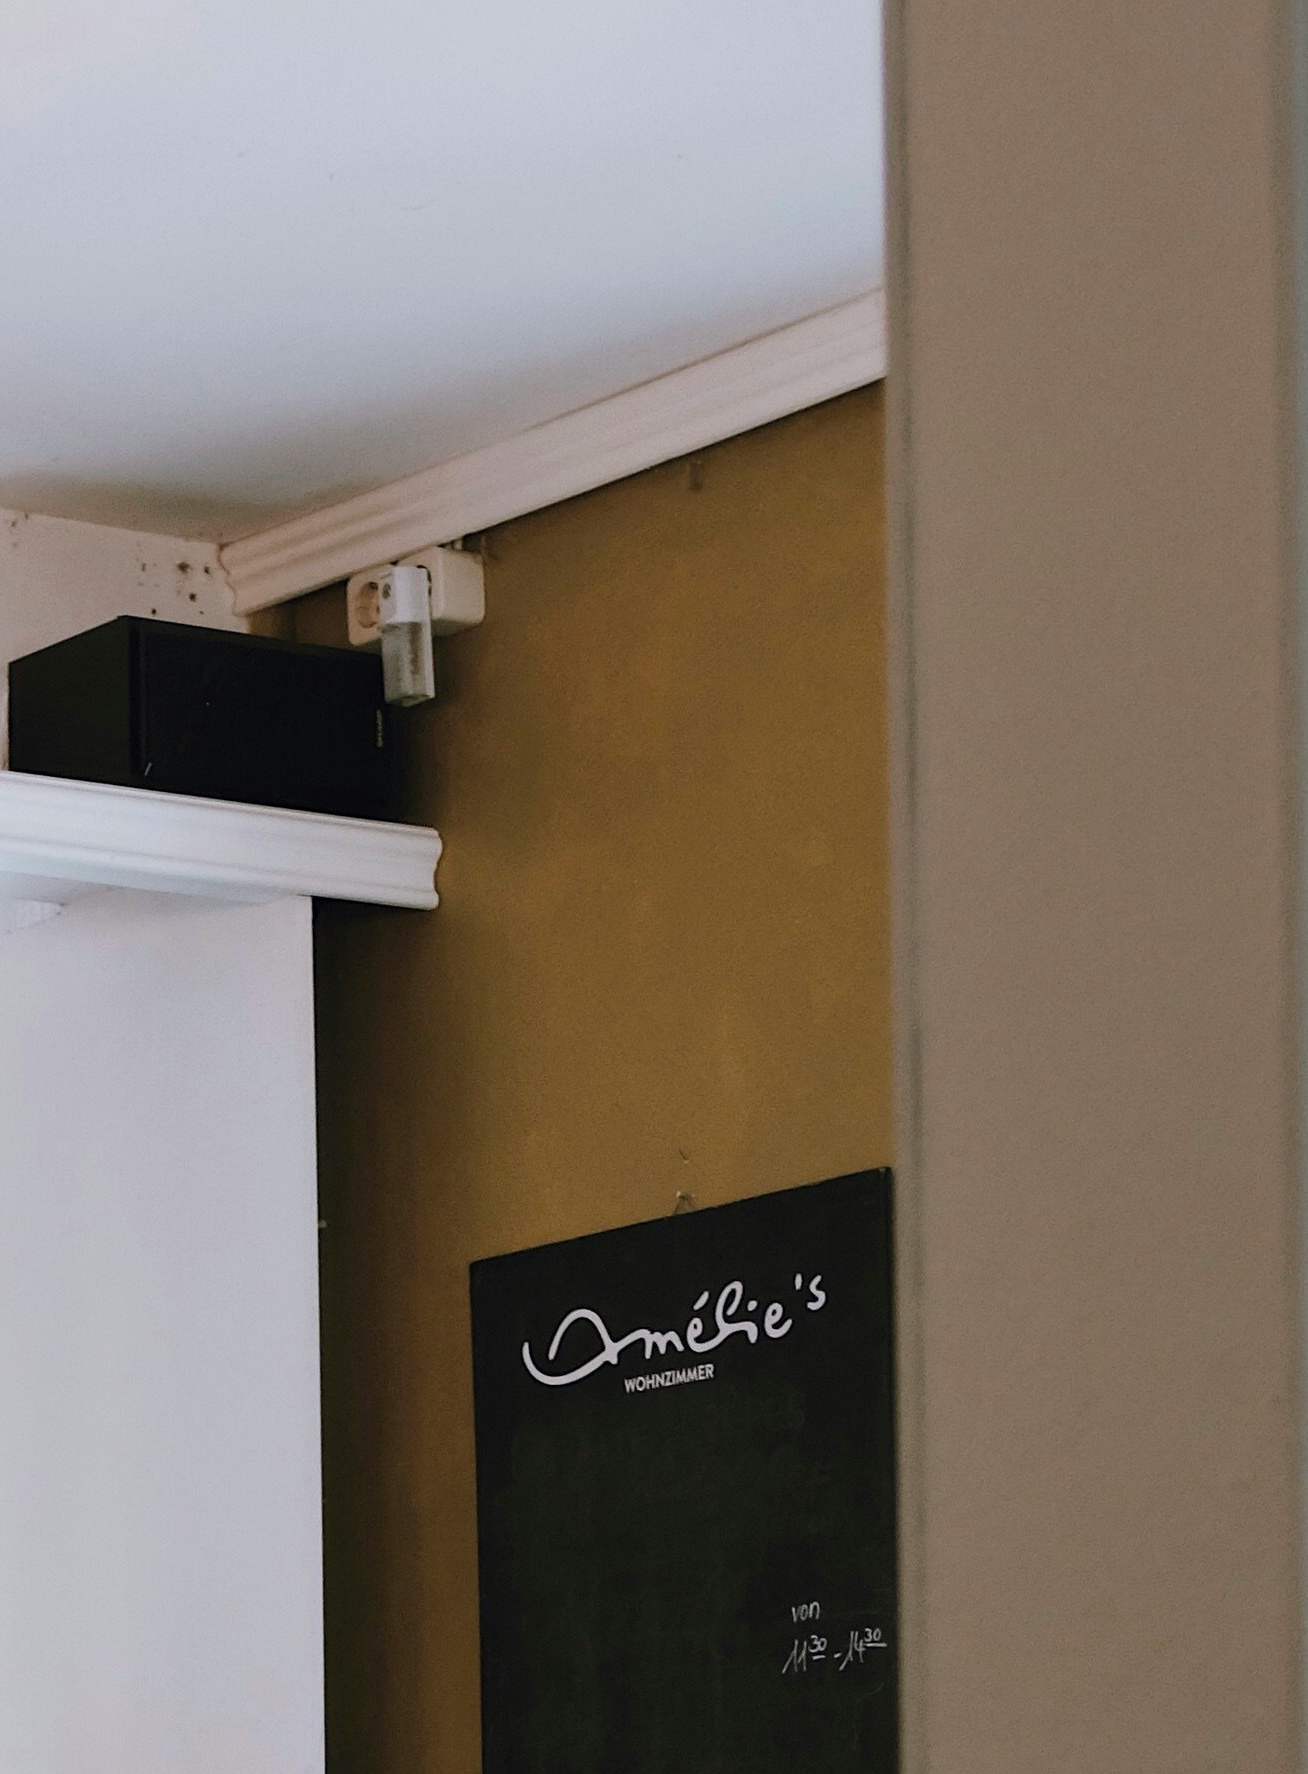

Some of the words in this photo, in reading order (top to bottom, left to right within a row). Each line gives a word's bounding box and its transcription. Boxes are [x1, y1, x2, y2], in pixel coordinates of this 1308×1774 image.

[523, 1273, 826, 1386] Amélie's
[624, 1363, 714, 1393] WOHNZIMMER
[792, 1601, 820, 1623] von
